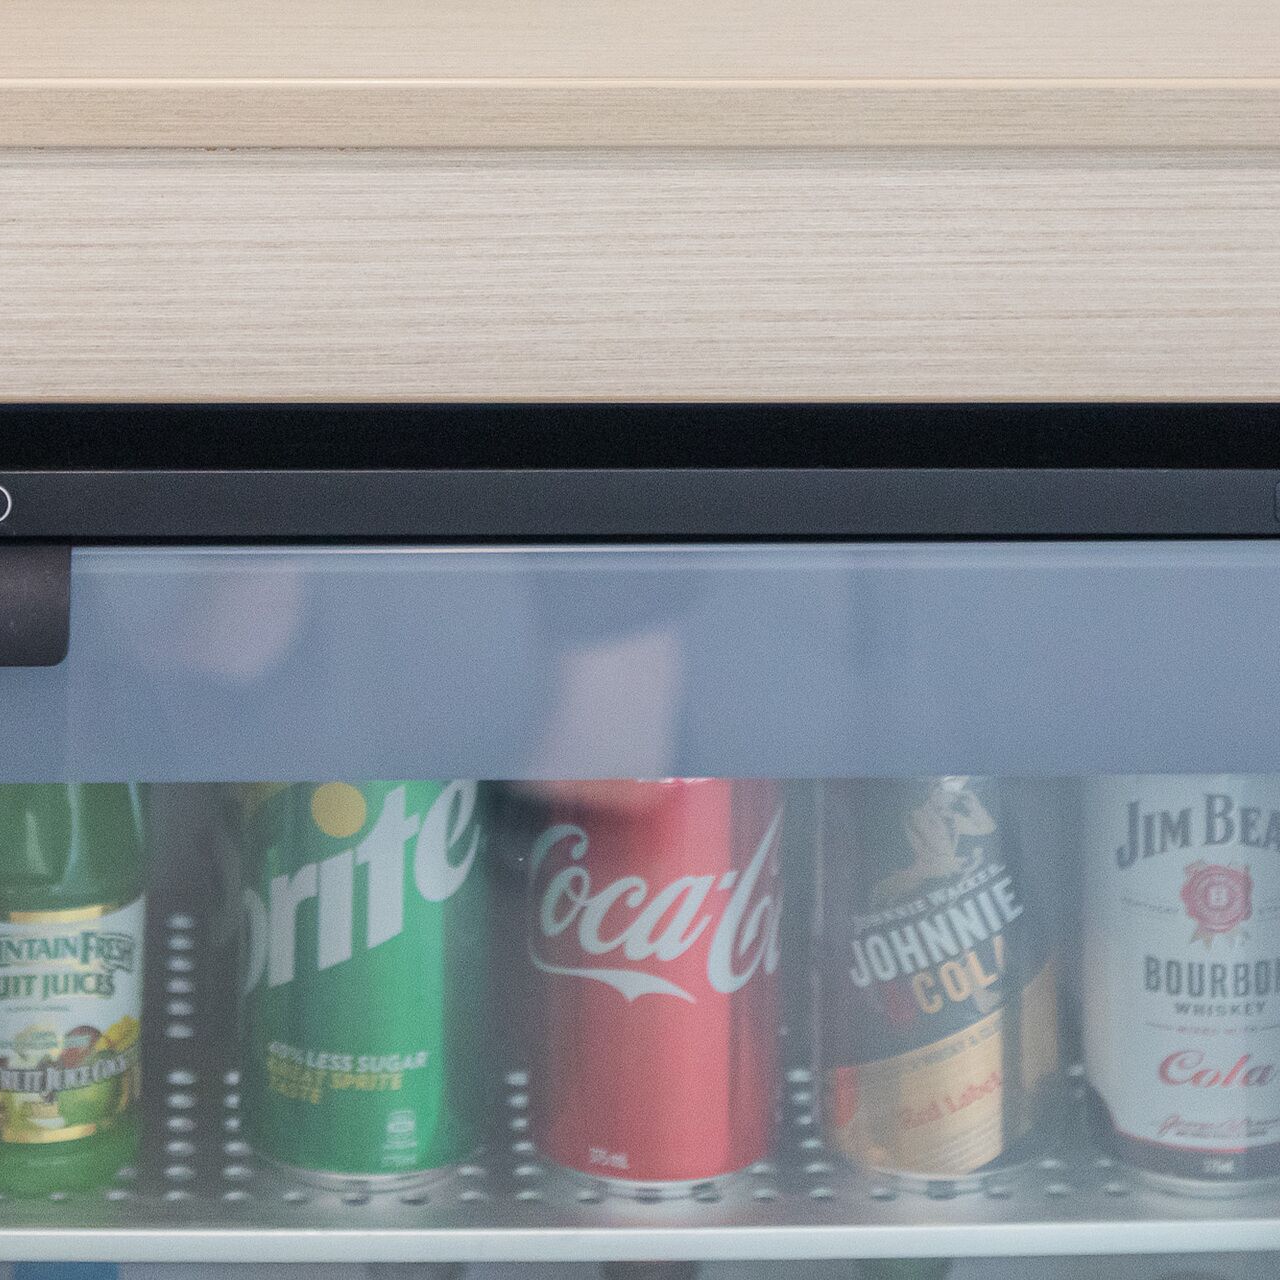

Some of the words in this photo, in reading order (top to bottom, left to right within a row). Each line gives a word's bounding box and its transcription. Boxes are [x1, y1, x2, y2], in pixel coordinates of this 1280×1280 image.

[1116, 800, 1192, 870] JIM
[849, 875, 1024, 988] JOHNNIE
[79, 930, 136, 975] FRESH
[41, 970, 117, 1001] JUICES
[1173, 1000, 1267, 1018] WHISKEY
[306, 1049, 354, 1072] LESS
[356, 1049, 430, 1074] SUGAR
[1156, 1048, 1277, 1088] Cola
